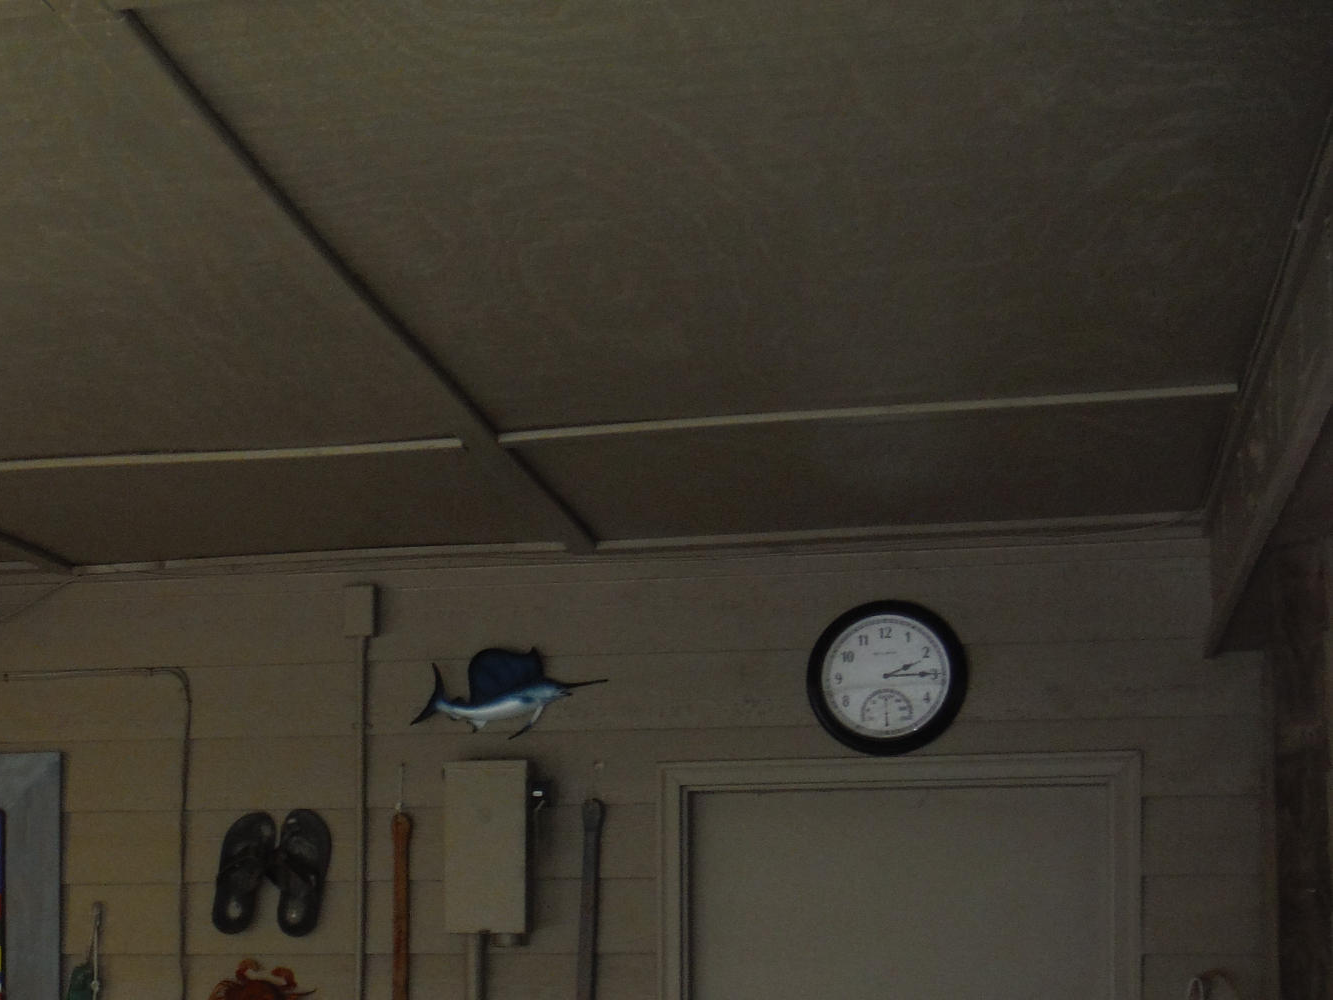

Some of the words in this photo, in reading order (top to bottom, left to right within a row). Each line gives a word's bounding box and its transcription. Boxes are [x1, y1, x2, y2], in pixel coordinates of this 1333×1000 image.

[879, 626, 892, 639] 12
[905, 631, 911, 643] 1
[858, 634, 869, 646] 11
[842, 651, 855, 663] 10
[922, 646, 930, 659] 2
[834, 672, 843, 685] 9
[929, 668, 939, 681] 3
[841, 695, 850, 708] 8
[922, 691, 931, 704] 4
